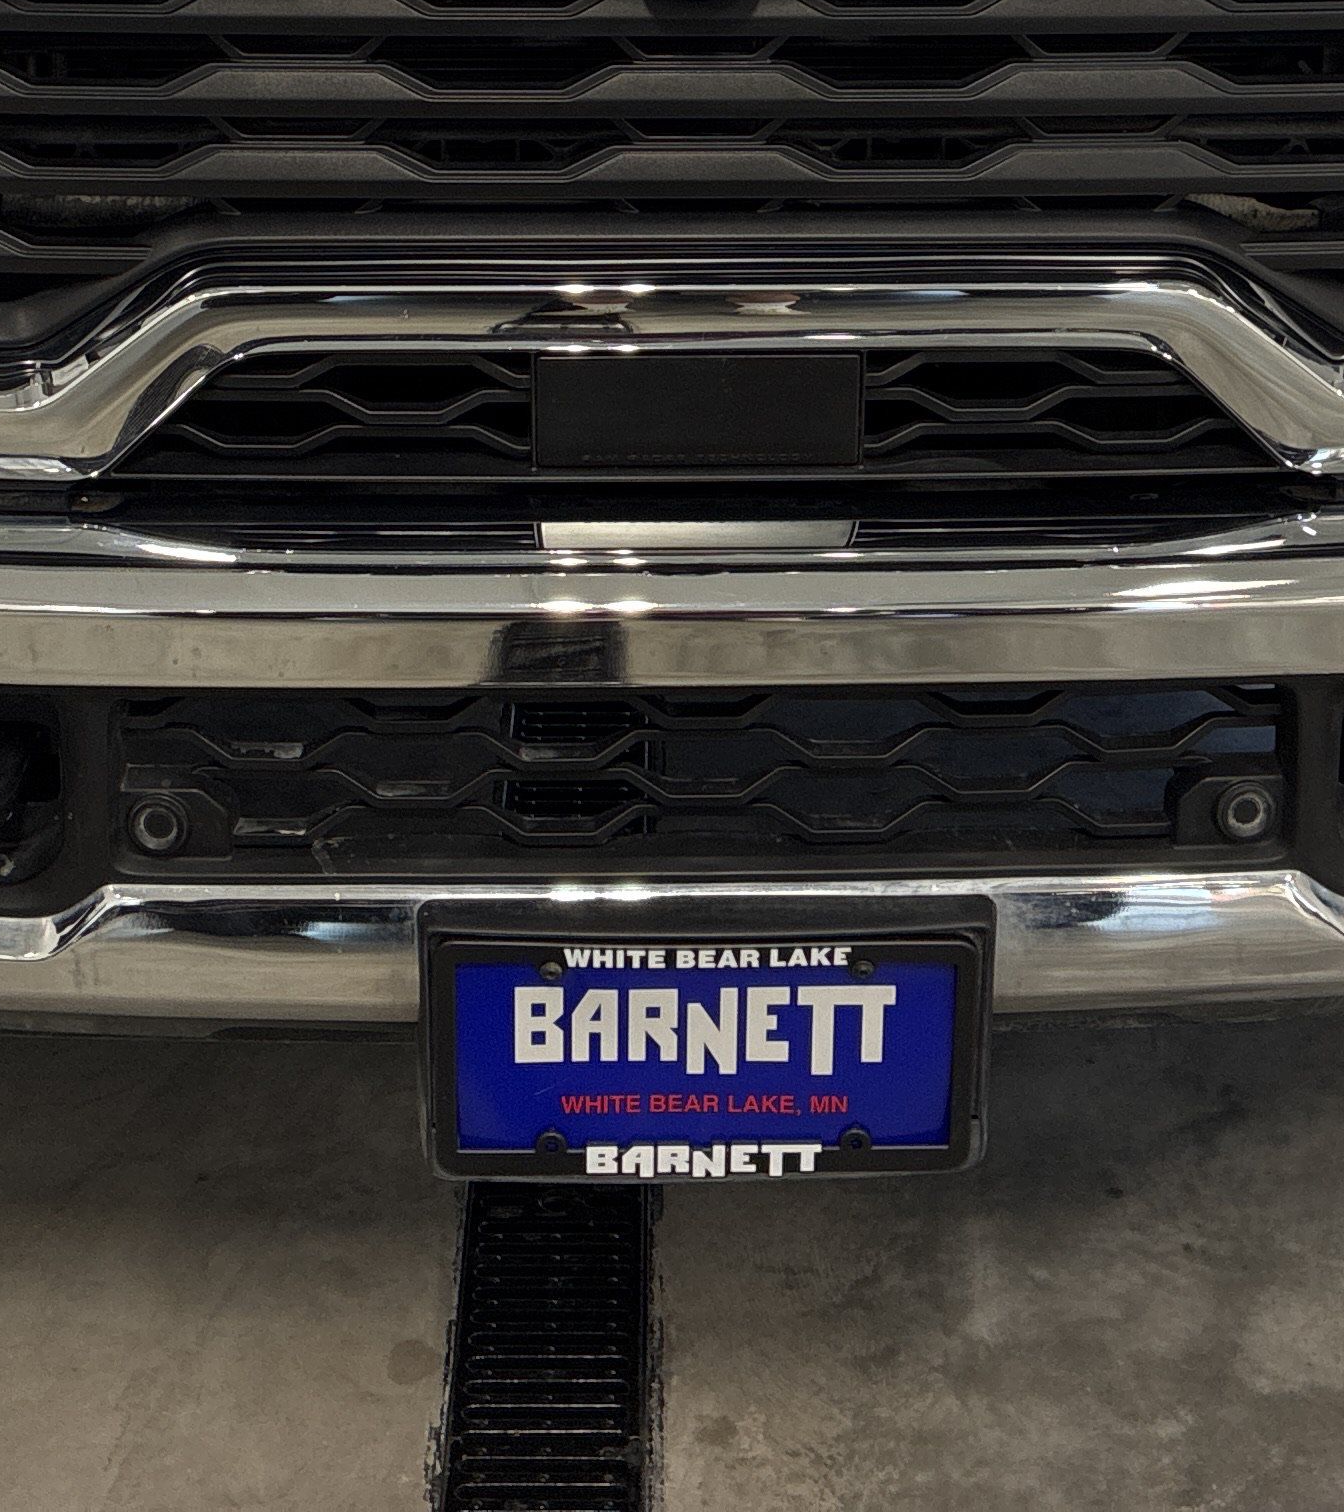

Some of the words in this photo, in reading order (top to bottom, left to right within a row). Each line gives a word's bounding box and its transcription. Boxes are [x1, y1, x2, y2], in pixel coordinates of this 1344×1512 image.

[562, 948, 666, 970] WHITE
[675, 949, 760, 969] BEAR
[768, 947, 853, 968] LAKE
[513, 984, 897, 1076] BARNETT
[560, 1094, 641, 1115] WHITE
[648, 1093, 719, 1114] BEAR
[726, 1094, 801, 1116] LAKE,
[809, 1094, 849, 1114] MN
[585, 1142, 823, 1178] BARNETT
